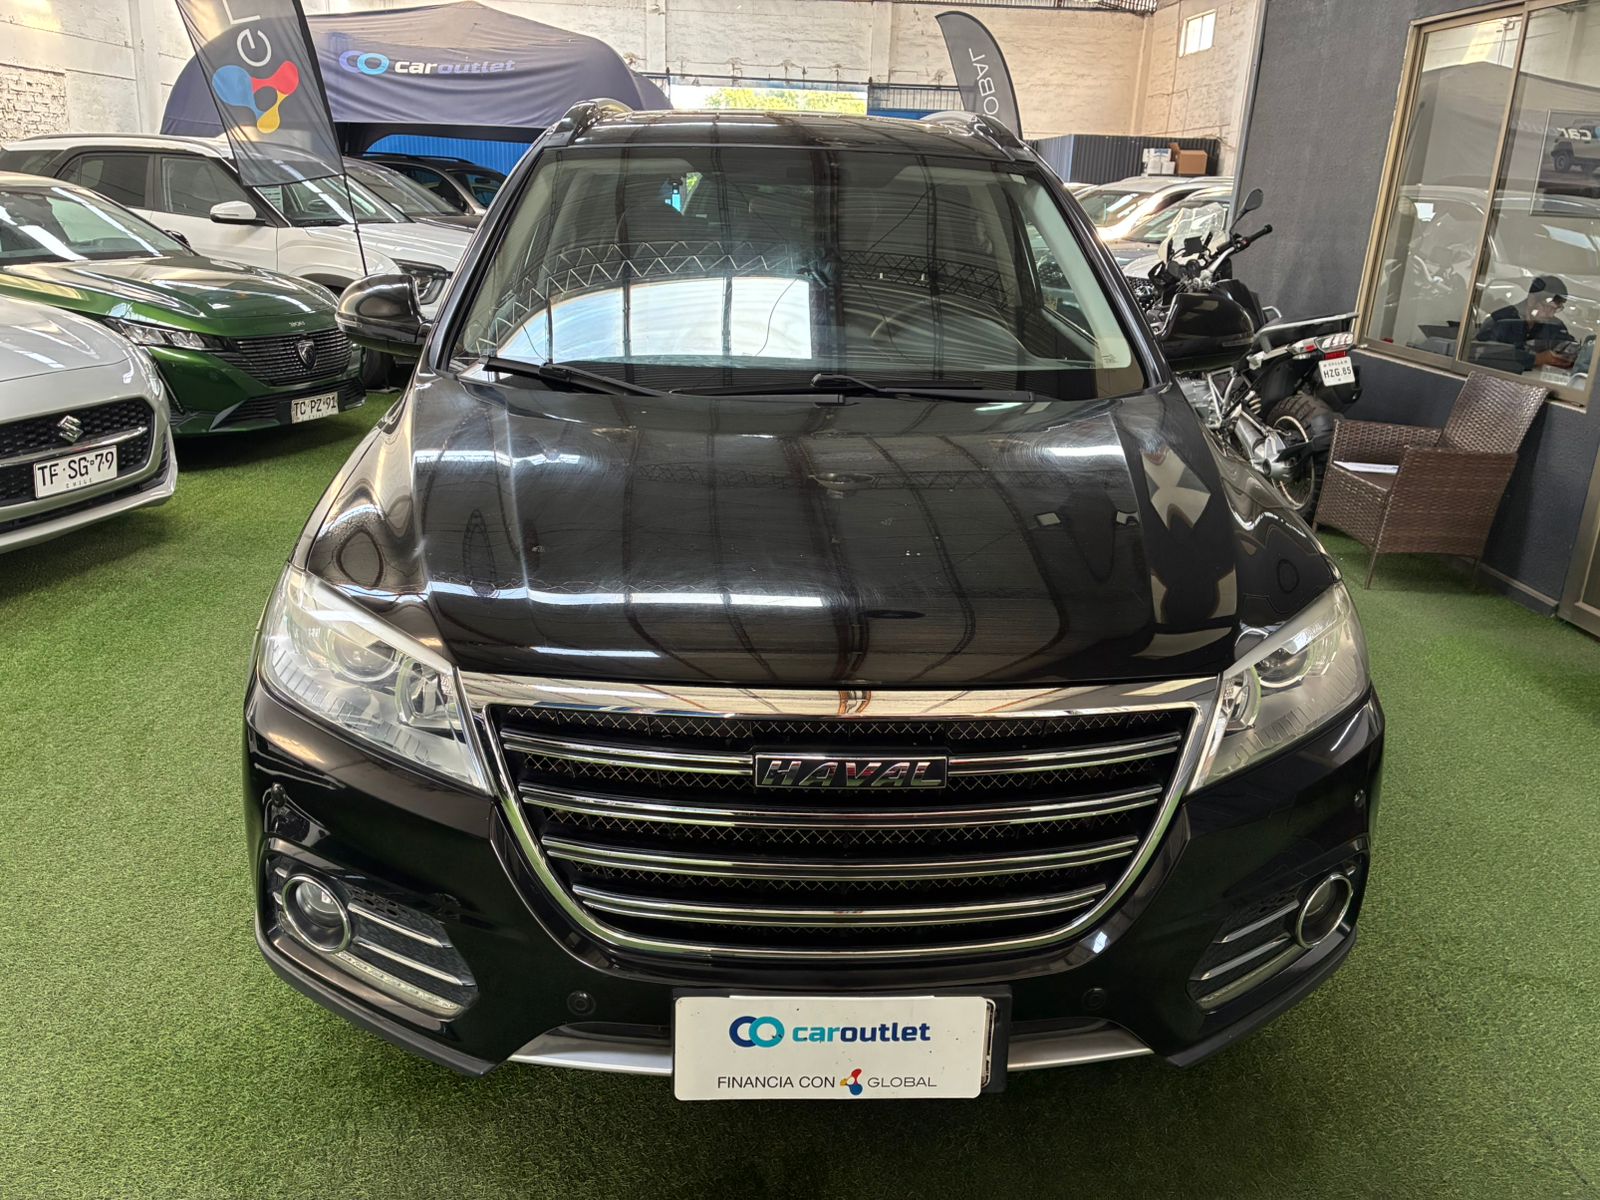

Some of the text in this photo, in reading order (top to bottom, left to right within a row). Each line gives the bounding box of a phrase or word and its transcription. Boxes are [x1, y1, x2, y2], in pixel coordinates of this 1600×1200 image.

[394, 59, 516, 75] caroutlet
[761, 760, 942, 787] HAVAL
[792, 1022, 931, 1043] caroutlet
[717, 1076, 938, 1089] FINANCIA CON GLOBAL
